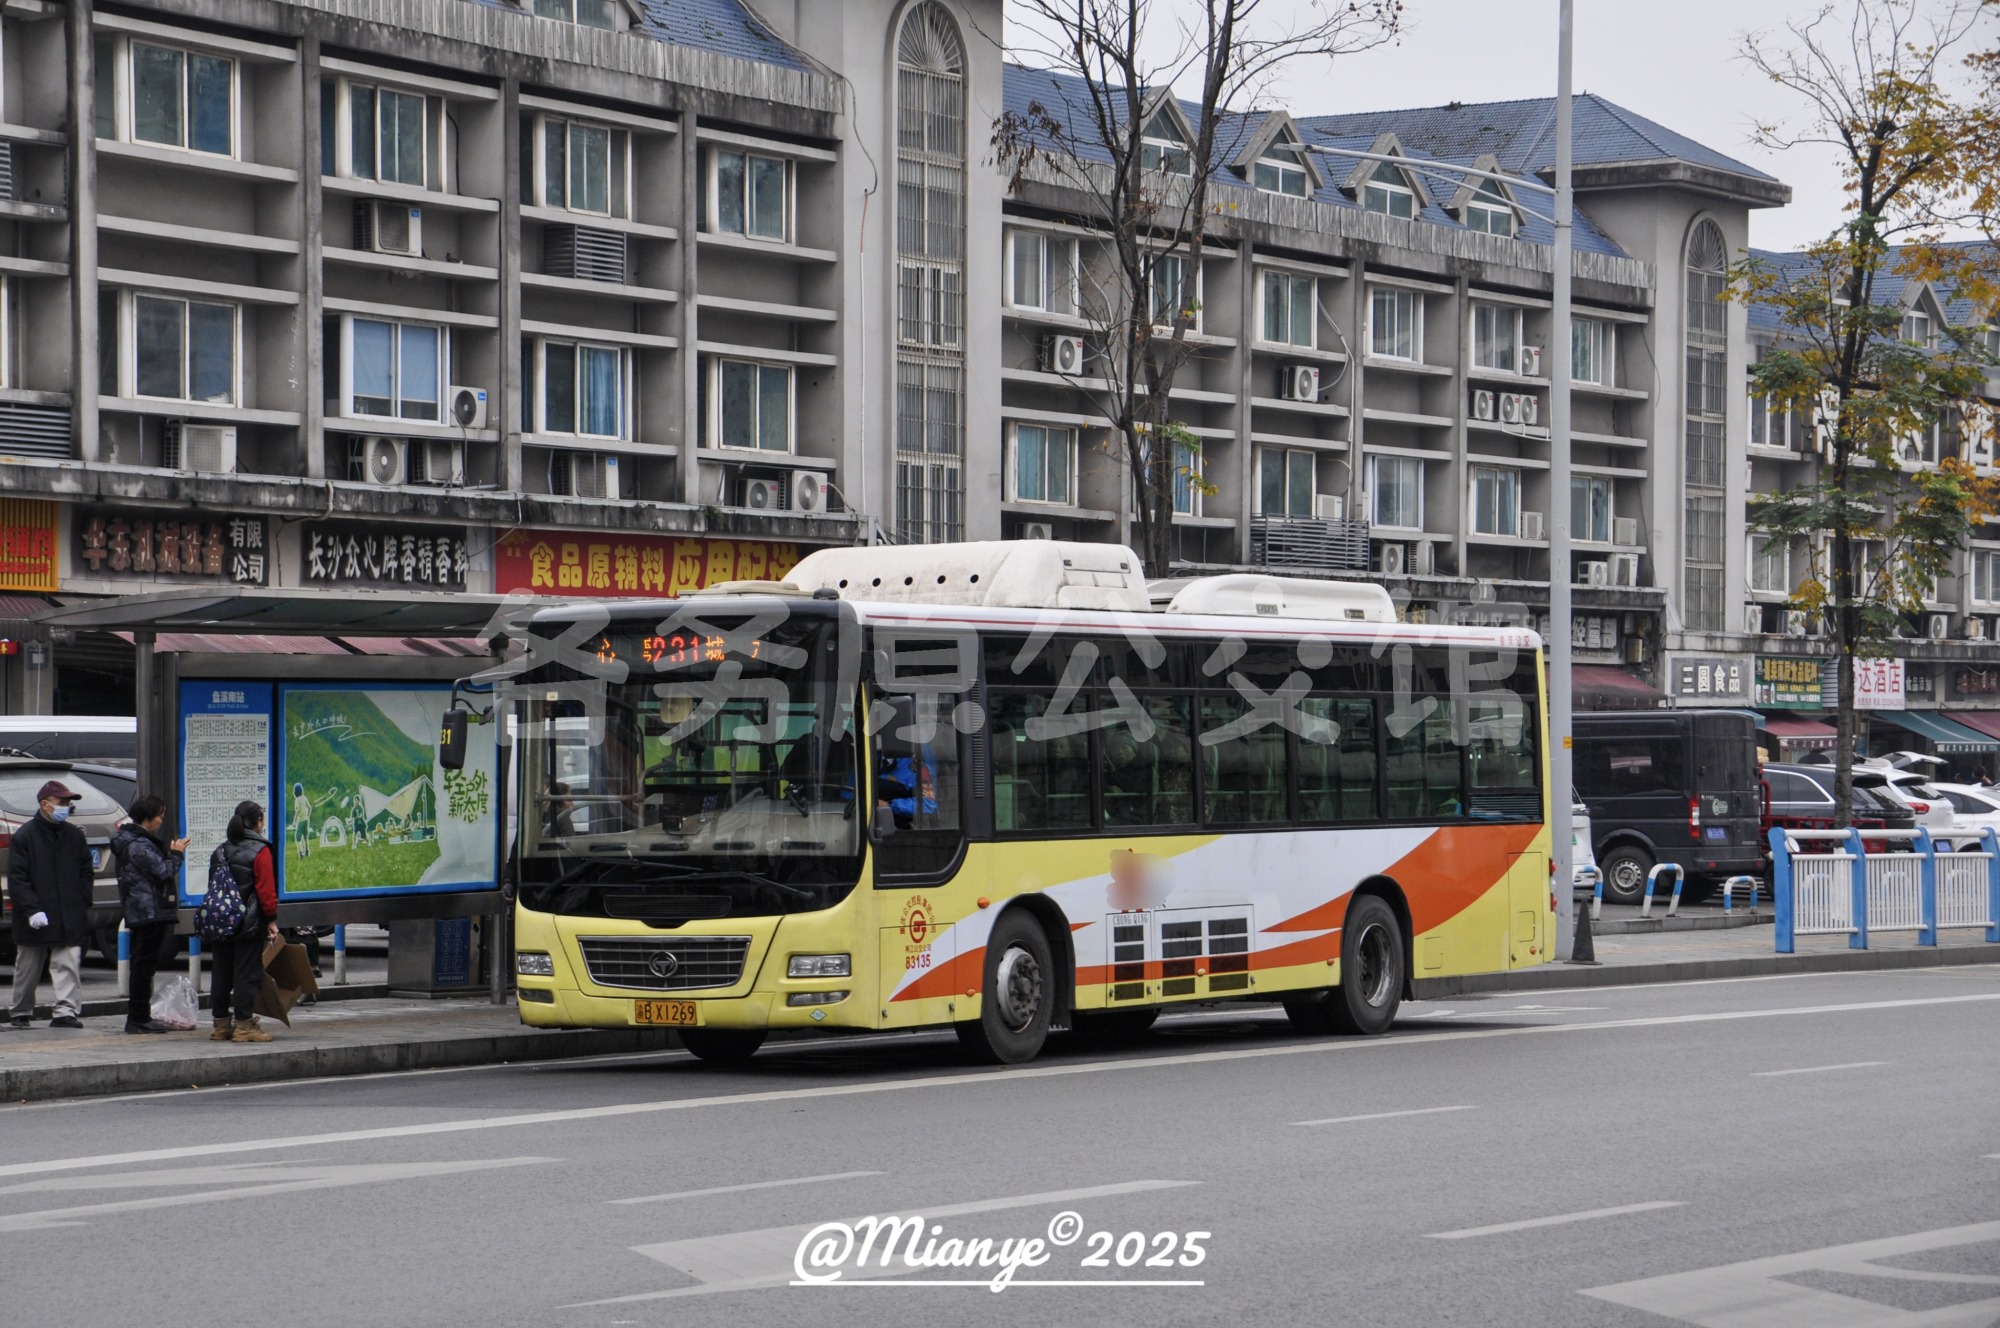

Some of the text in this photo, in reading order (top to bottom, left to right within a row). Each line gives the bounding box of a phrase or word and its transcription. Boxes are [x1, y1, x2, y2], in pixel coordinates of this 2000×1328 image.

[229, 517, 263, 549] 有限
[231, 552, 264, 584] 公司
[1681, 664, 1741, 693] 三圆食品
[1853, 660, 1901, 695] 达酒店
[440, 728, 452, 745] 31
[1112, 913, 1148, 926] CHONG QING
[905, 954, 931, 970] 83135
